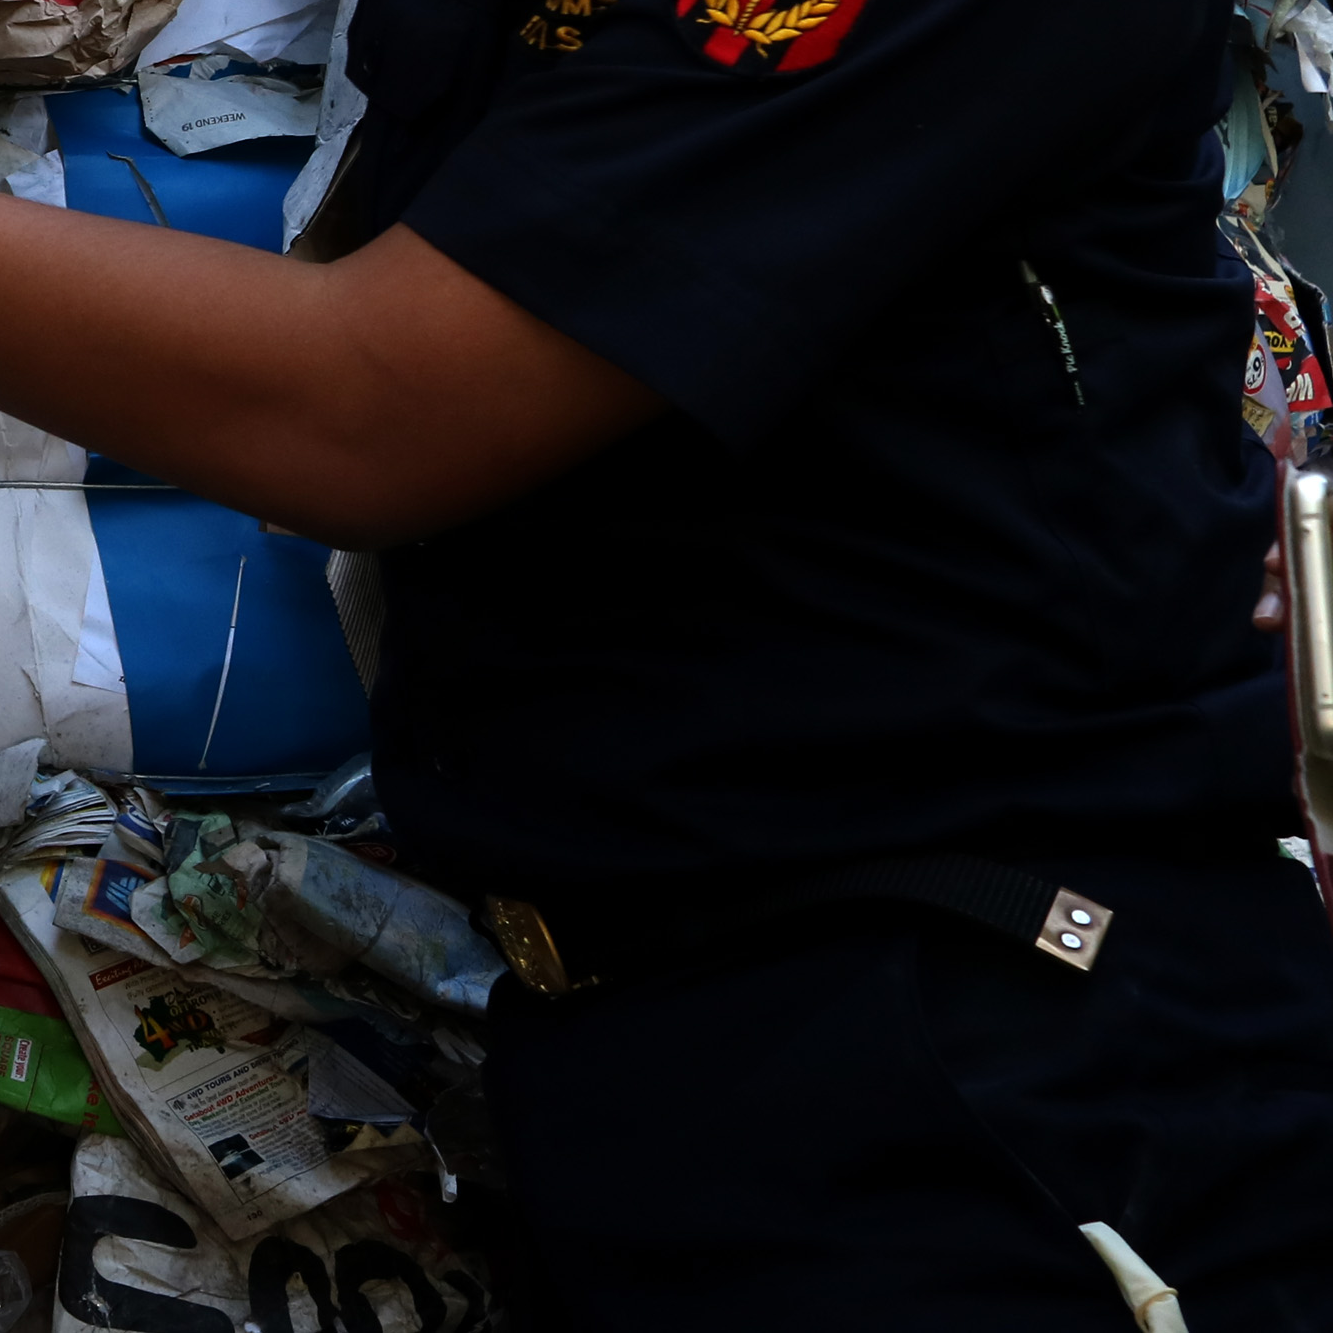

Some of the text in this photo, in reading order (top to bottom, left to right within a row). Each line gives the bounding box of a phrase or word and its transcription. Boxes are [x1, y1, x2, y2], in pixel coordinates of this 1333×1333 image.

[181, 112, 247, 132] WEEKEND 19
[203, 1074, 232, 1092] TOURS
[232, 1065, 250, 1079] AND
